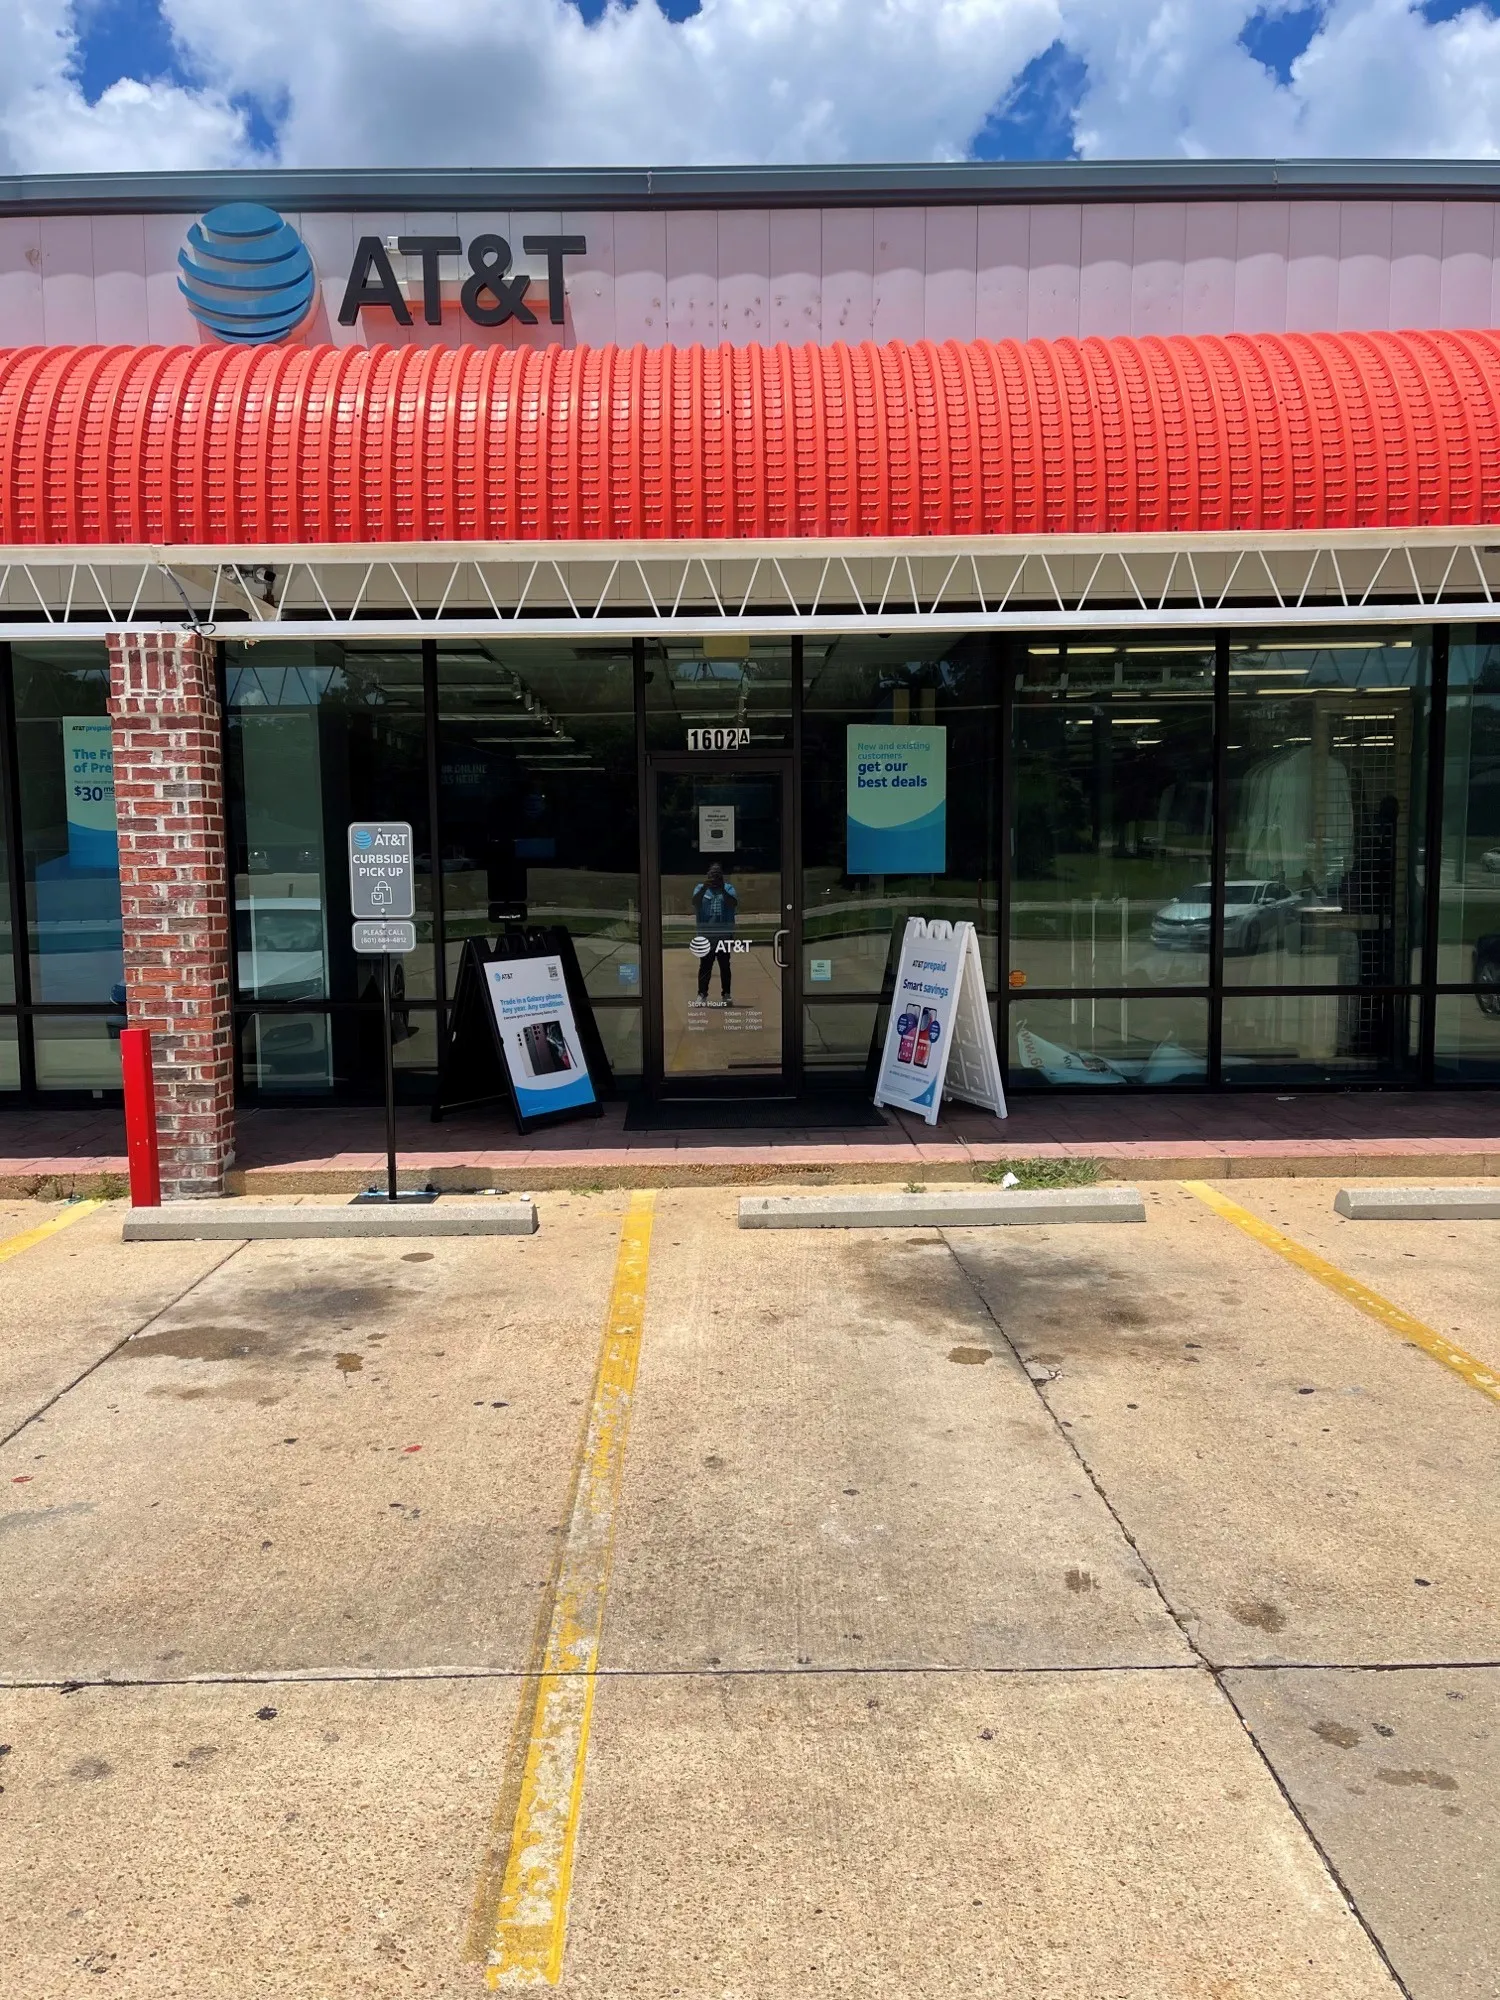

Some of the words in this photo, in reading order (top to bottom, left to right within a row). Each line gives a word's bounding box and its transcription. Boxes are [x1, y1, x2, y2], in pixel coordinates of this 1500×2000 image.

[338, 234, 586, 326] AT&T
[878, 742, 894, 750] and
[897, 742, 930, 751] existing
[72, 749, 97, 759] The
[73, 763, 87, 773] of
[858, 762, 881, 775] get
[885, 763, 908, 772] our
[858, 776, 888, 788] best
[891, 775, 928, 787] deals
[74, 786, 103, 801] $30
[374, 834, 408, 846] AT&T
[352, 854, 409, 864] CURBSIDE
[359, 867, 385, 877] PICK
[388, 867, 403, 877] UP
[715, 939, 752, 953] AT&T
[912, 960, 923, 968] AT&T
[923, 961, 947, 972] prepaid
[903, 979, 923, 992] Smart
[923, 984, 949, 998] savings
[500, 998, 516, 1006] Trade
[527, 995, 545, 1003] Galaxy
[502, 1006, 513, 1014] Any
[513, 1005, 527, 1013] year.
[539, 1000, 565, 1009] condition.
